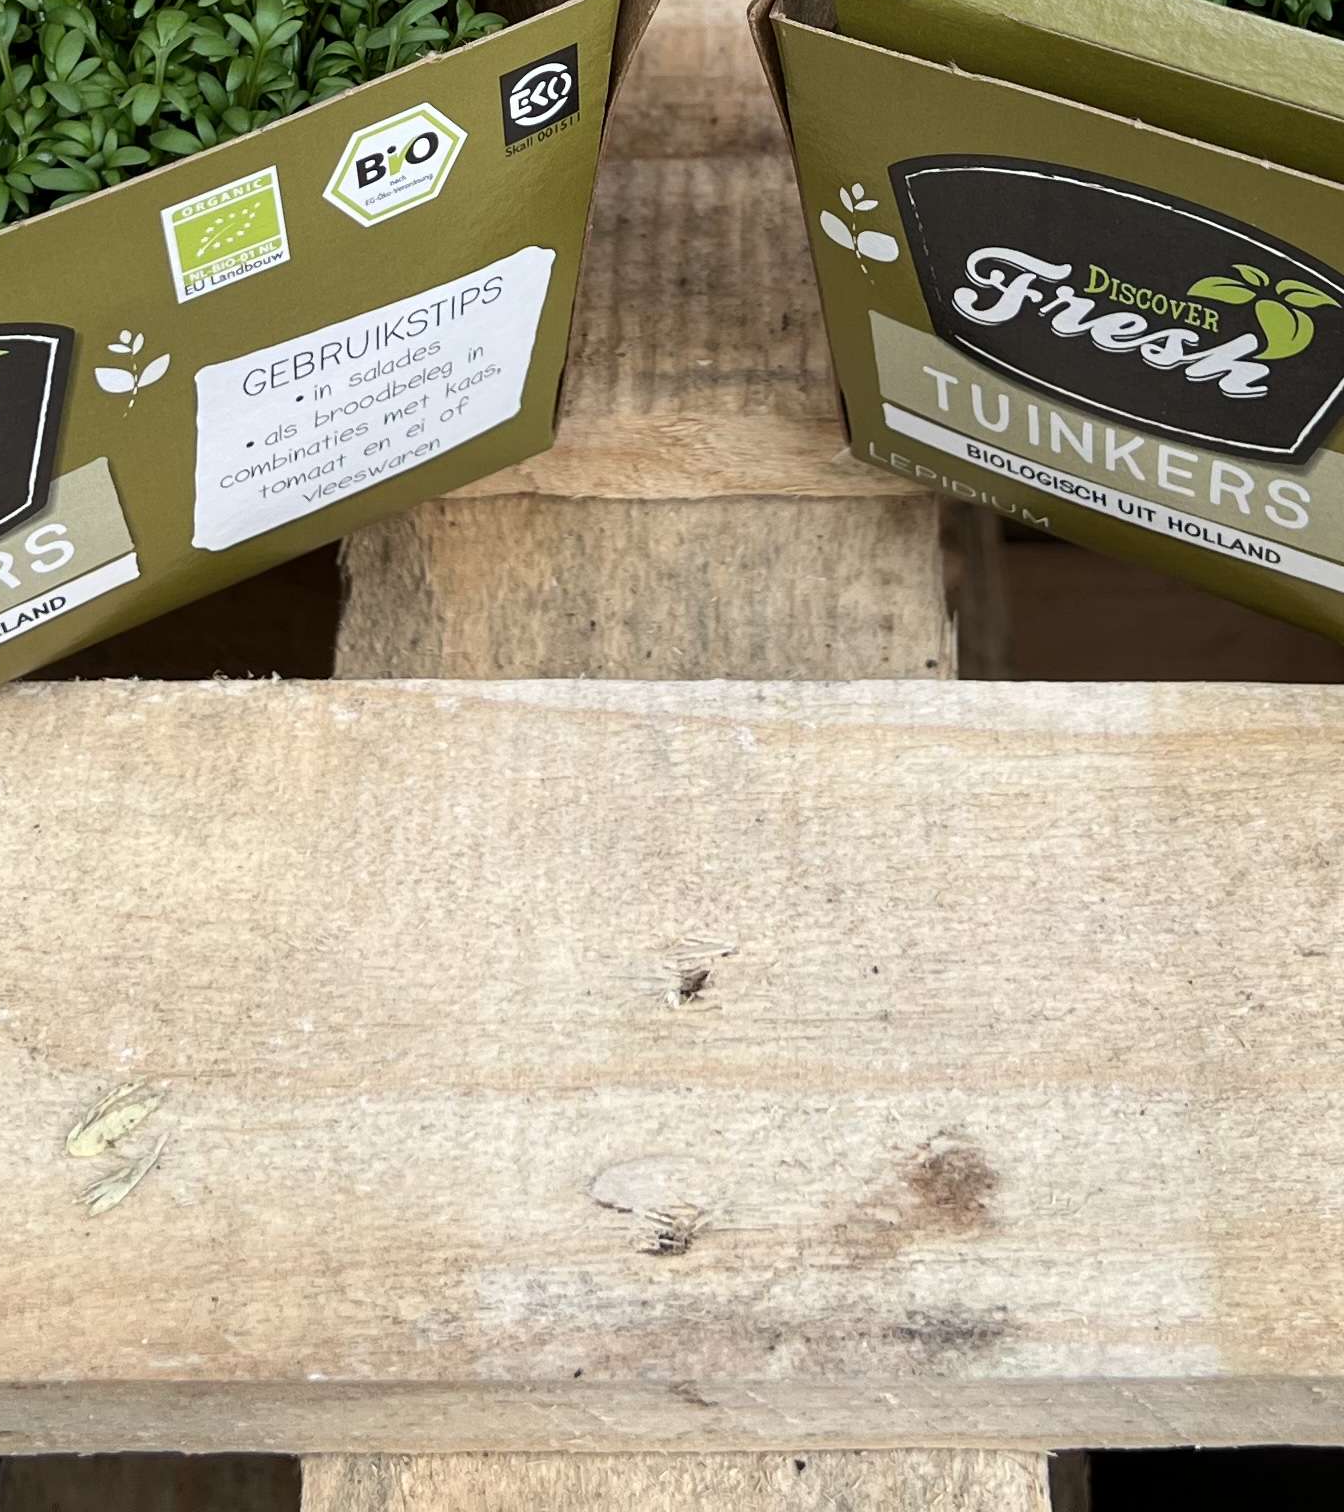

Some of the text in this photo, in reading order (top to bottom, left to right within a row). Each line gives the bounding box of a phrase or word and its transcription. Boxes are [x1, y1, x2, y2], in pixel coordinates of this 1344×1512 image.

[182, 178, 264, 217] ORGANIC
[185, 251, 284, 296] EU Landbouw
[951, 246, 1271, 399] Fresh
[242, 276, 503, 396] GEBRUIKSTIPS
[313, 340, 442, 401] in salades
[219, 366, 502, 490] combinaties met kaas,
[263, 344, 484, 447] als broodbeleg in
[258, 396, 470, 499] tomaat en ei of
[302, 437, 441, 503] vleeswaren
[868, 441, 1049, 529] LEPIDIUM
[922, 365, 1313, 531] TUINKERS
[965, 442, 1282, 566] BIOLOGISCH UIT HOLLAND
